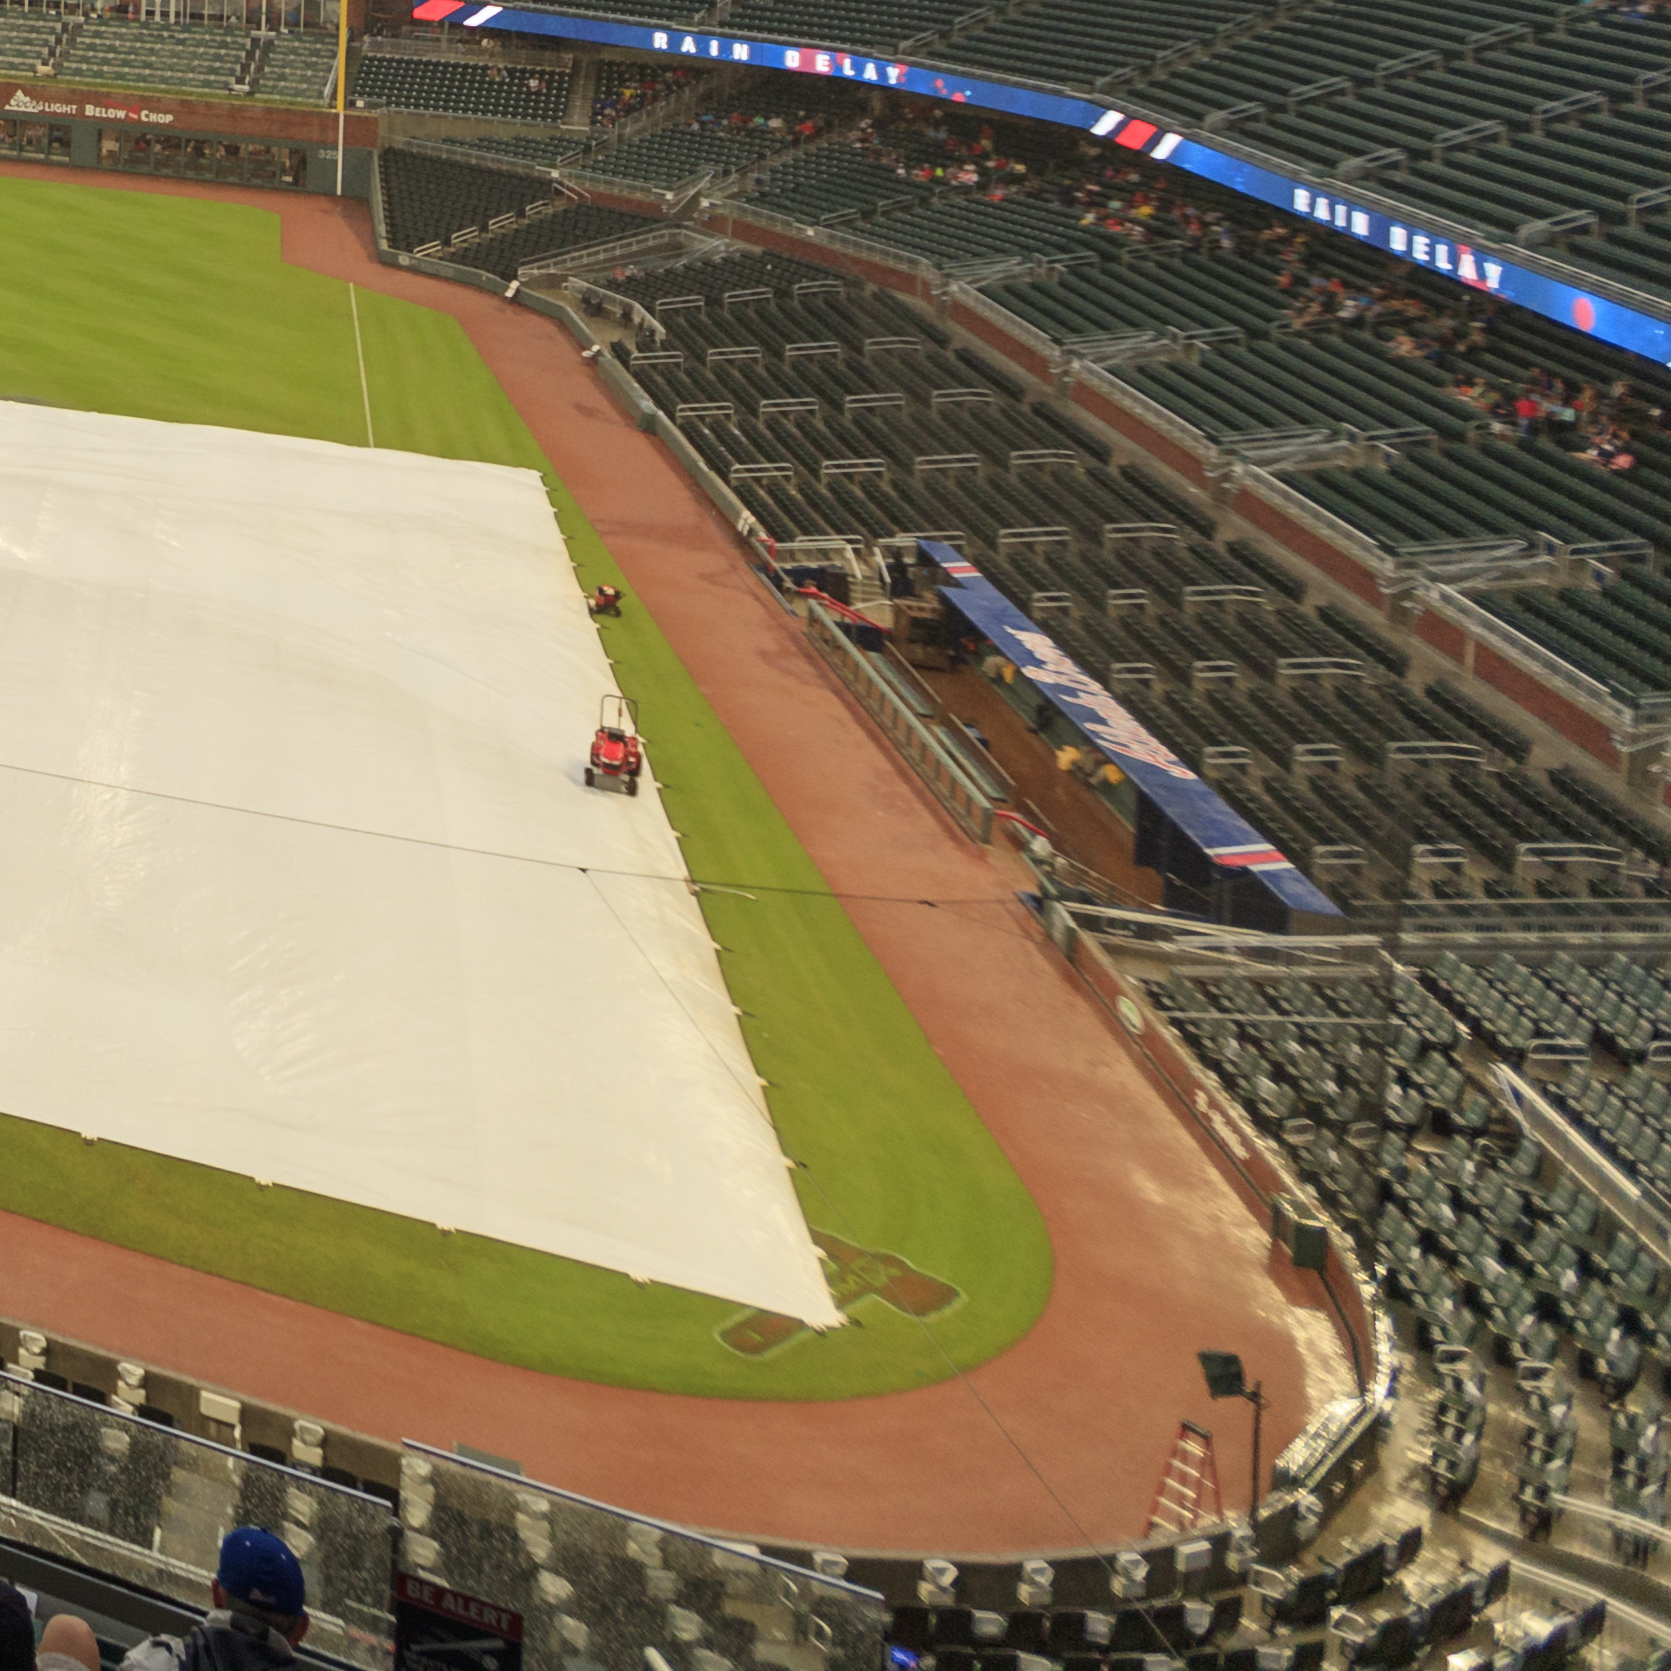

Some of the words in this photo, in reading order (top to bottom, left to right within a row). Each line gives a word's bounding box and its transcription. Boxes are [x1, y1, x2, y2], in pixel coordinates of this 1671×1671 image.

[652, 31, 750, 61] RAIN
[784, 49, 900, 85] DELAY
[9, 93, 44, 112] Coors
[44, 103, 78, 115] LIGHT
[85, 103, 127, 120] BELOW
[140, 109, 174, 124] CHOP
[1293, 187, 1370, 237] RAIN
[1389, 225, 1503, 289] DELAY
[406, 1579, 435, 1605] BE
[441, 1592, 513, 1631] ALERT
